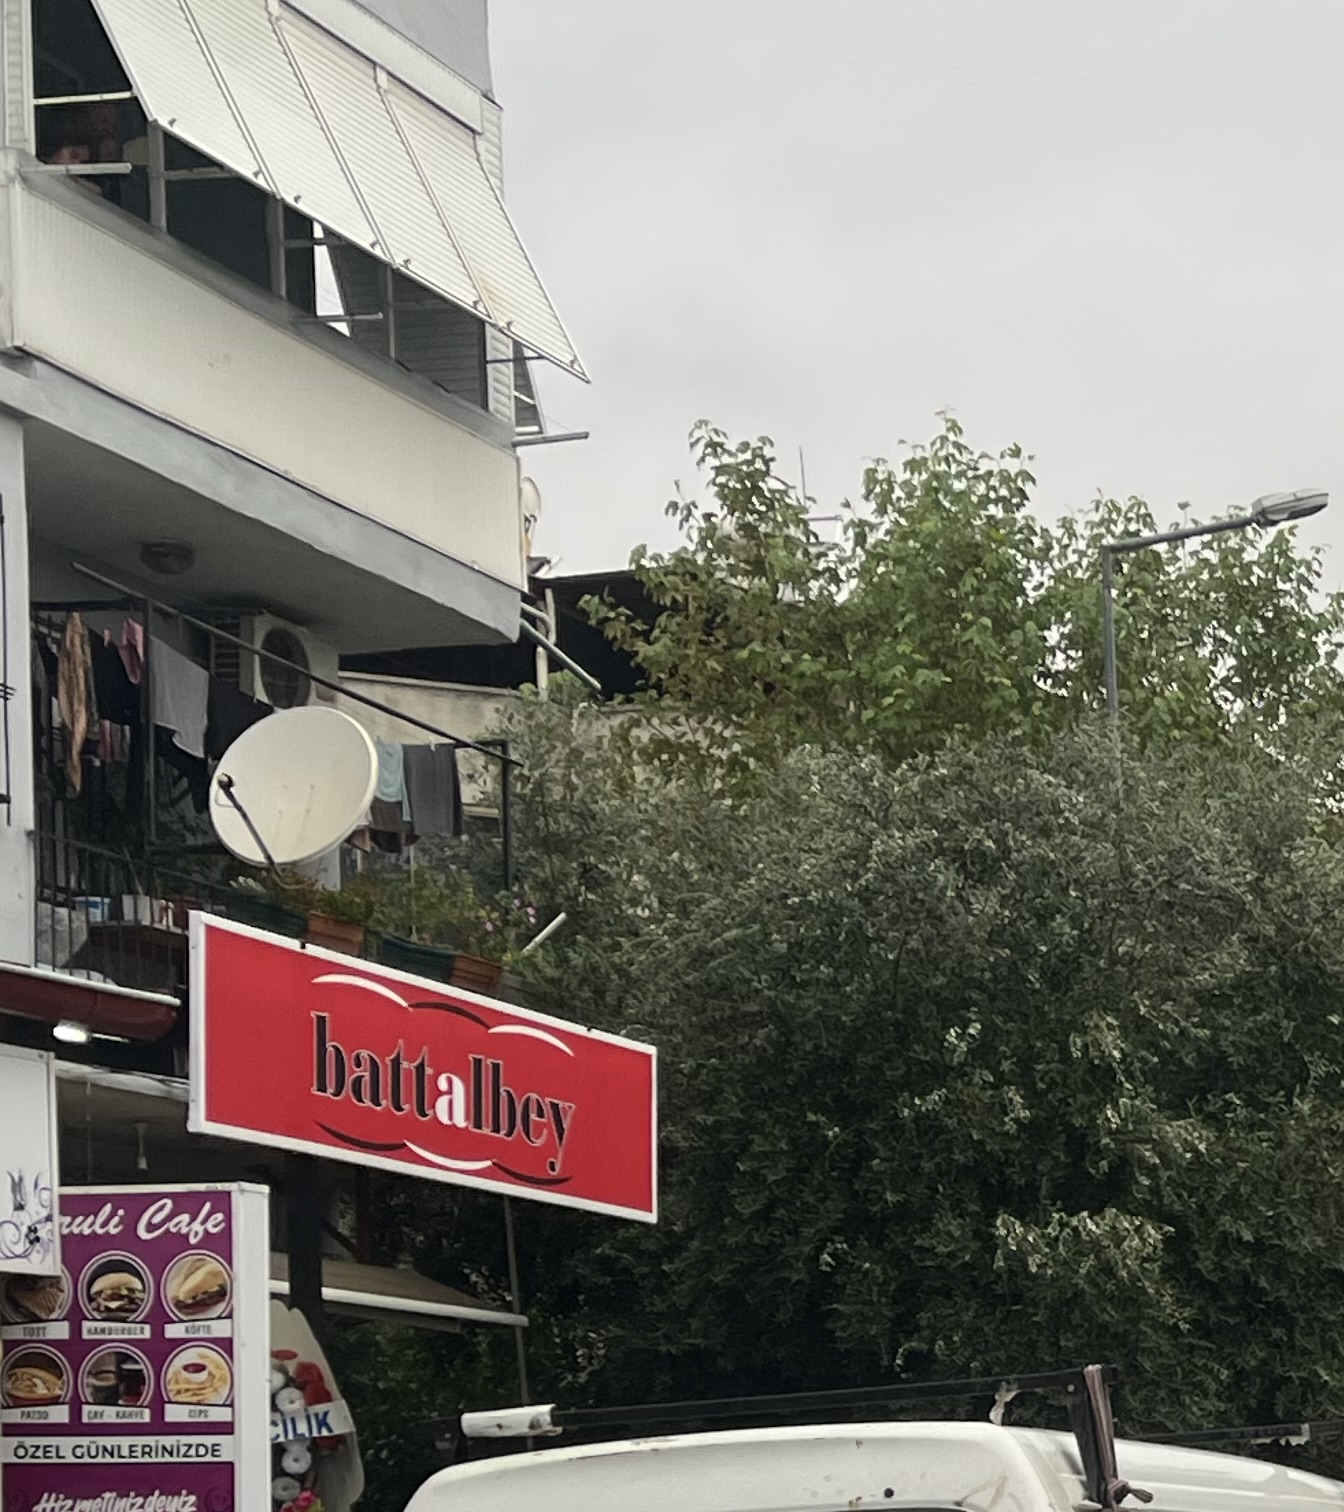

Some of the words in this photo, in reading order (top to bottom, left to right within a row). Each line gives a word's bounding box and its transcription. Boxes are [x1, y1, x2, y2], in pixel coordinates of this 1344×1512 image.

[310, 1010, 576, 1175] battalbey
[136, 1197, 227, 1245] Cafe
[86, 1325, 145, 1337] HAMBURGER
[13, 1440, 66, 1460] ÖZEL
[71, 1438, 223, 1460] GÜNLERİNİZDE
